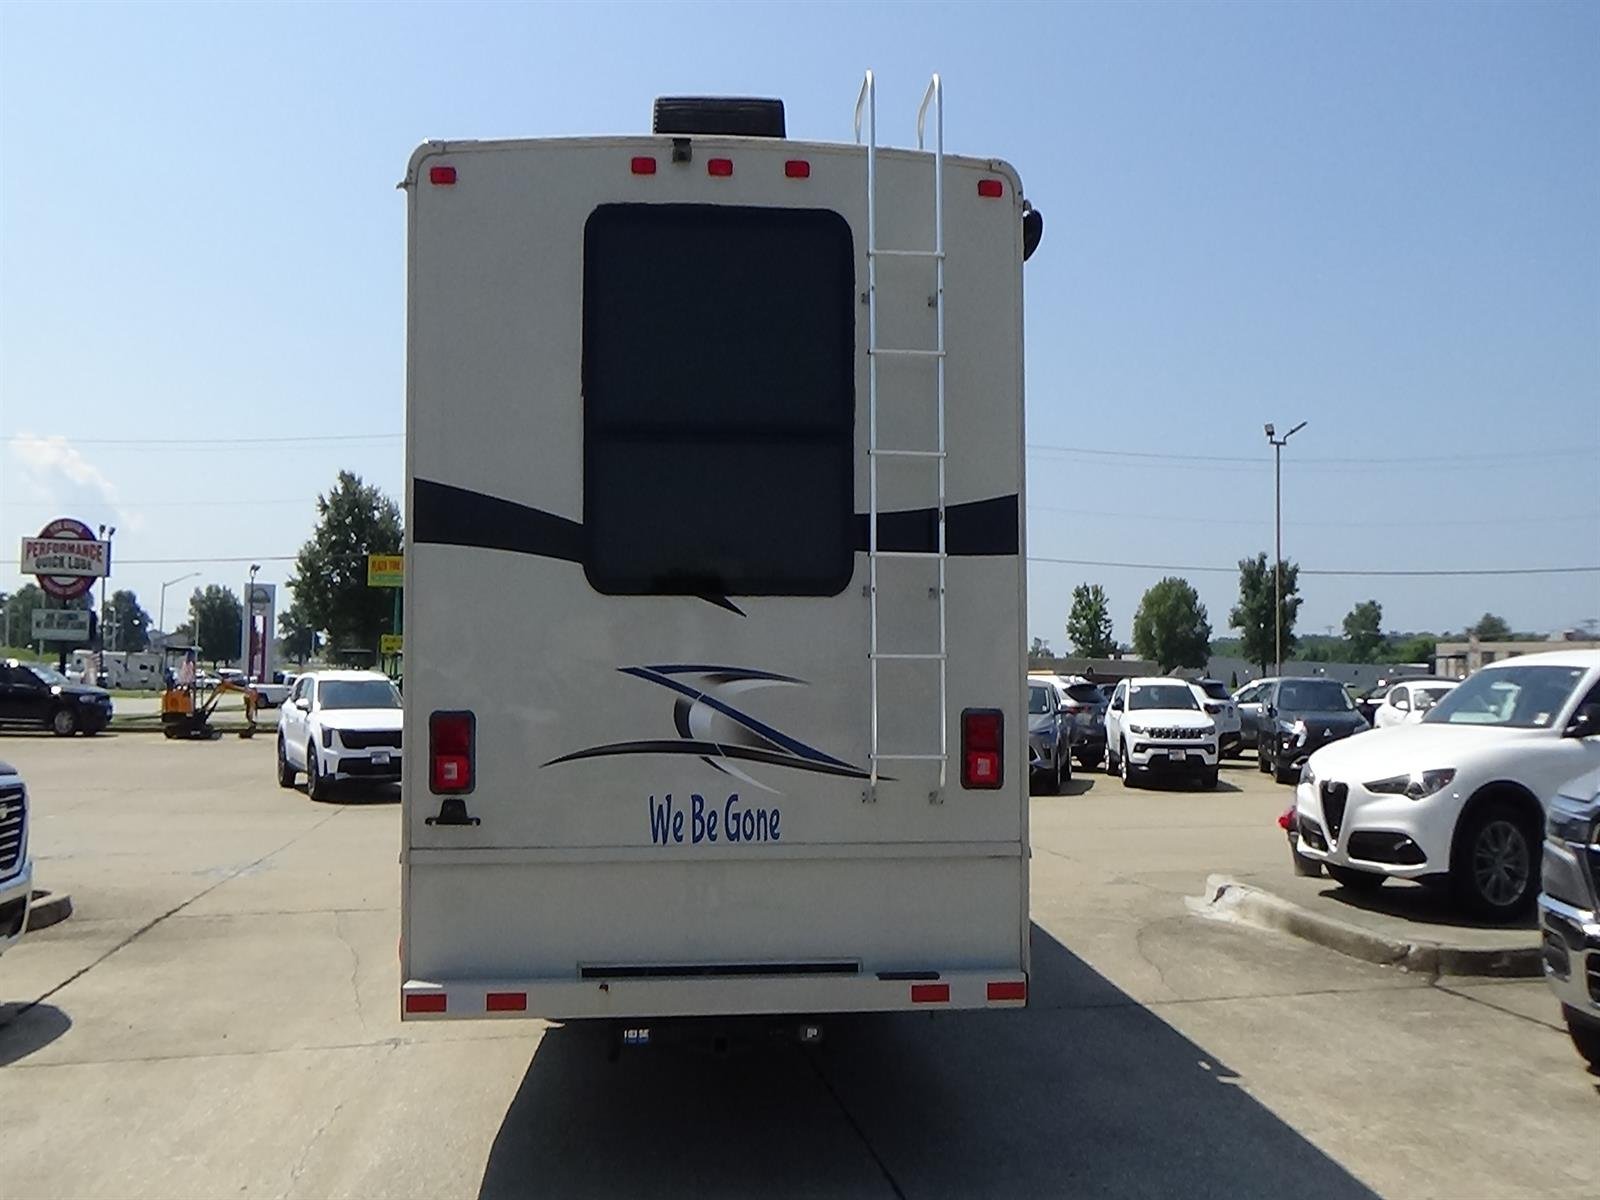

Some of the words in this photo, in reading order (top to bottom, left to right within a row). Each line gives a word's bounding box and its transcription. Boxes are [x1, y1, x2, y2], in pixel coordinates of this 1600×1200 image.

[26, 541, 103, 562] PERFORMANCE
[35, 556, 65, 570] QUICK
[68, 556, 93, 571] LUBE
[649, 793, 684, 846] We
[690, 793, 719, 844] Be
[724, 793, 781, 842] Gone
